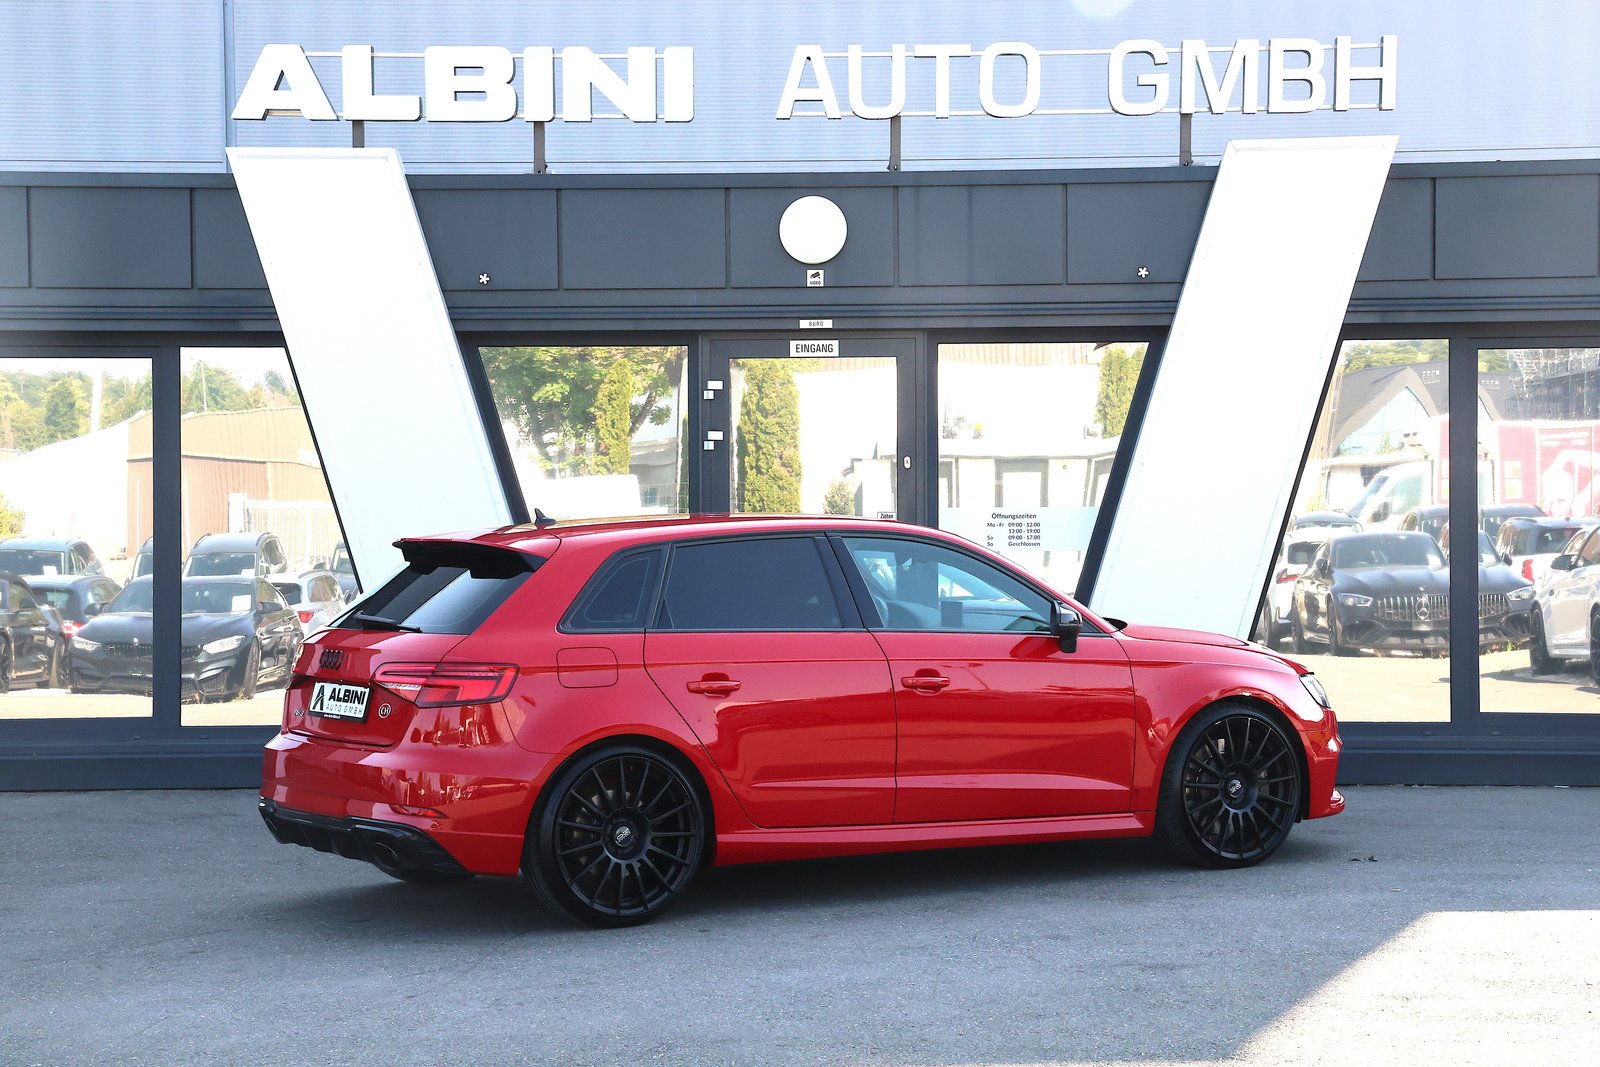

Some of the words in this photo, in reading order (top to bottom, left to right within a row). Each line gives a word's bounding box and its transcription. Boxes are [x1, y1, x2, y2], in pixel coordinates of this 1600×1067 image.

[231, 43, 695, 123] ALBINI
[776, 41, 1042, 120] AUTO
[1107, 34, 1399, 117] GMBH
[795, 344, 834, 352] EINGANG
[328, 688, 366, 705] ALBINI
[326, 703, 342, 712] AUTO
